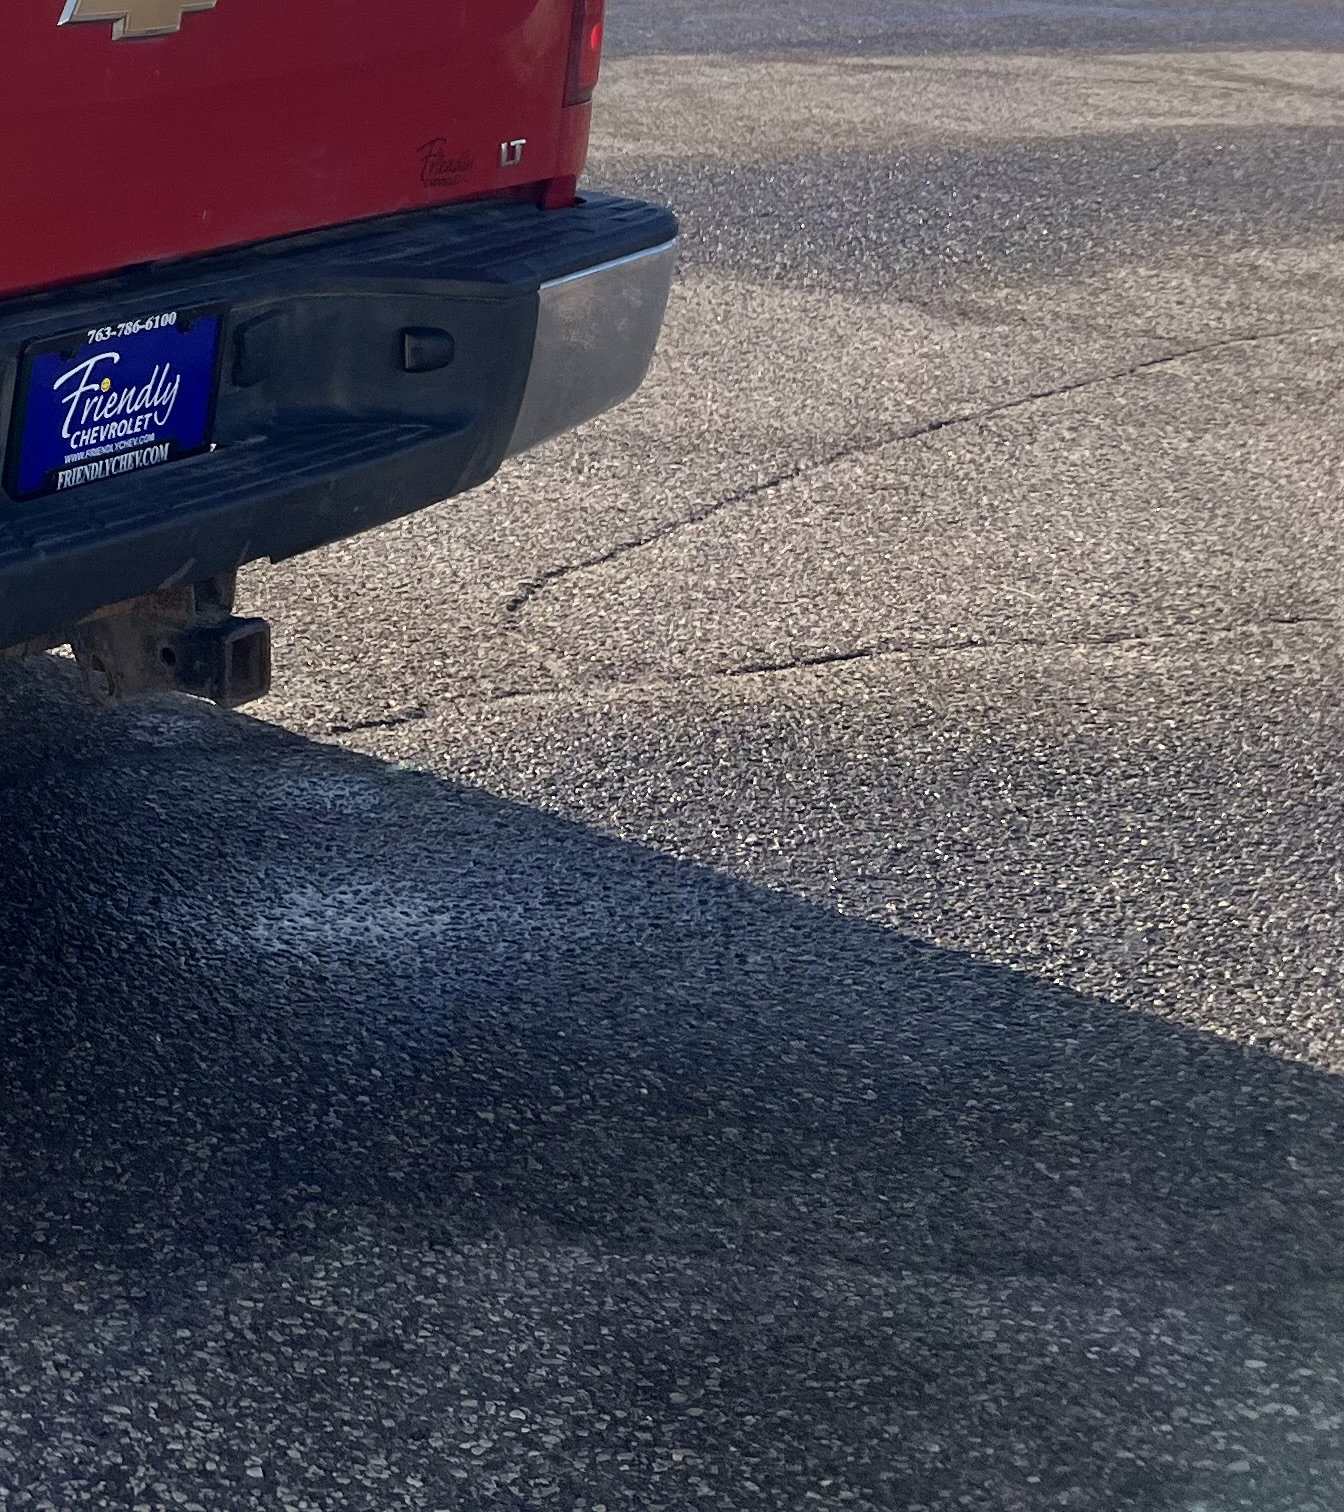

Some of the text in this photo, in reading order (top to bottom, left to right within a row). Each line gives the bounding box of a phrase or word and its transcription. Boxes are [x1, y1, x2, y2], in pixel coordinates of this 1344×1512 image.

[499, 138, 527, 168] LT
[87, 311, 178, 345] 763-786-6100
[53, 351, 181, 439] Friendly
[70, 412, 153, 450] CHEVROLET
[56, 442, 171, 490] FRIENDLYCHEV.COM
